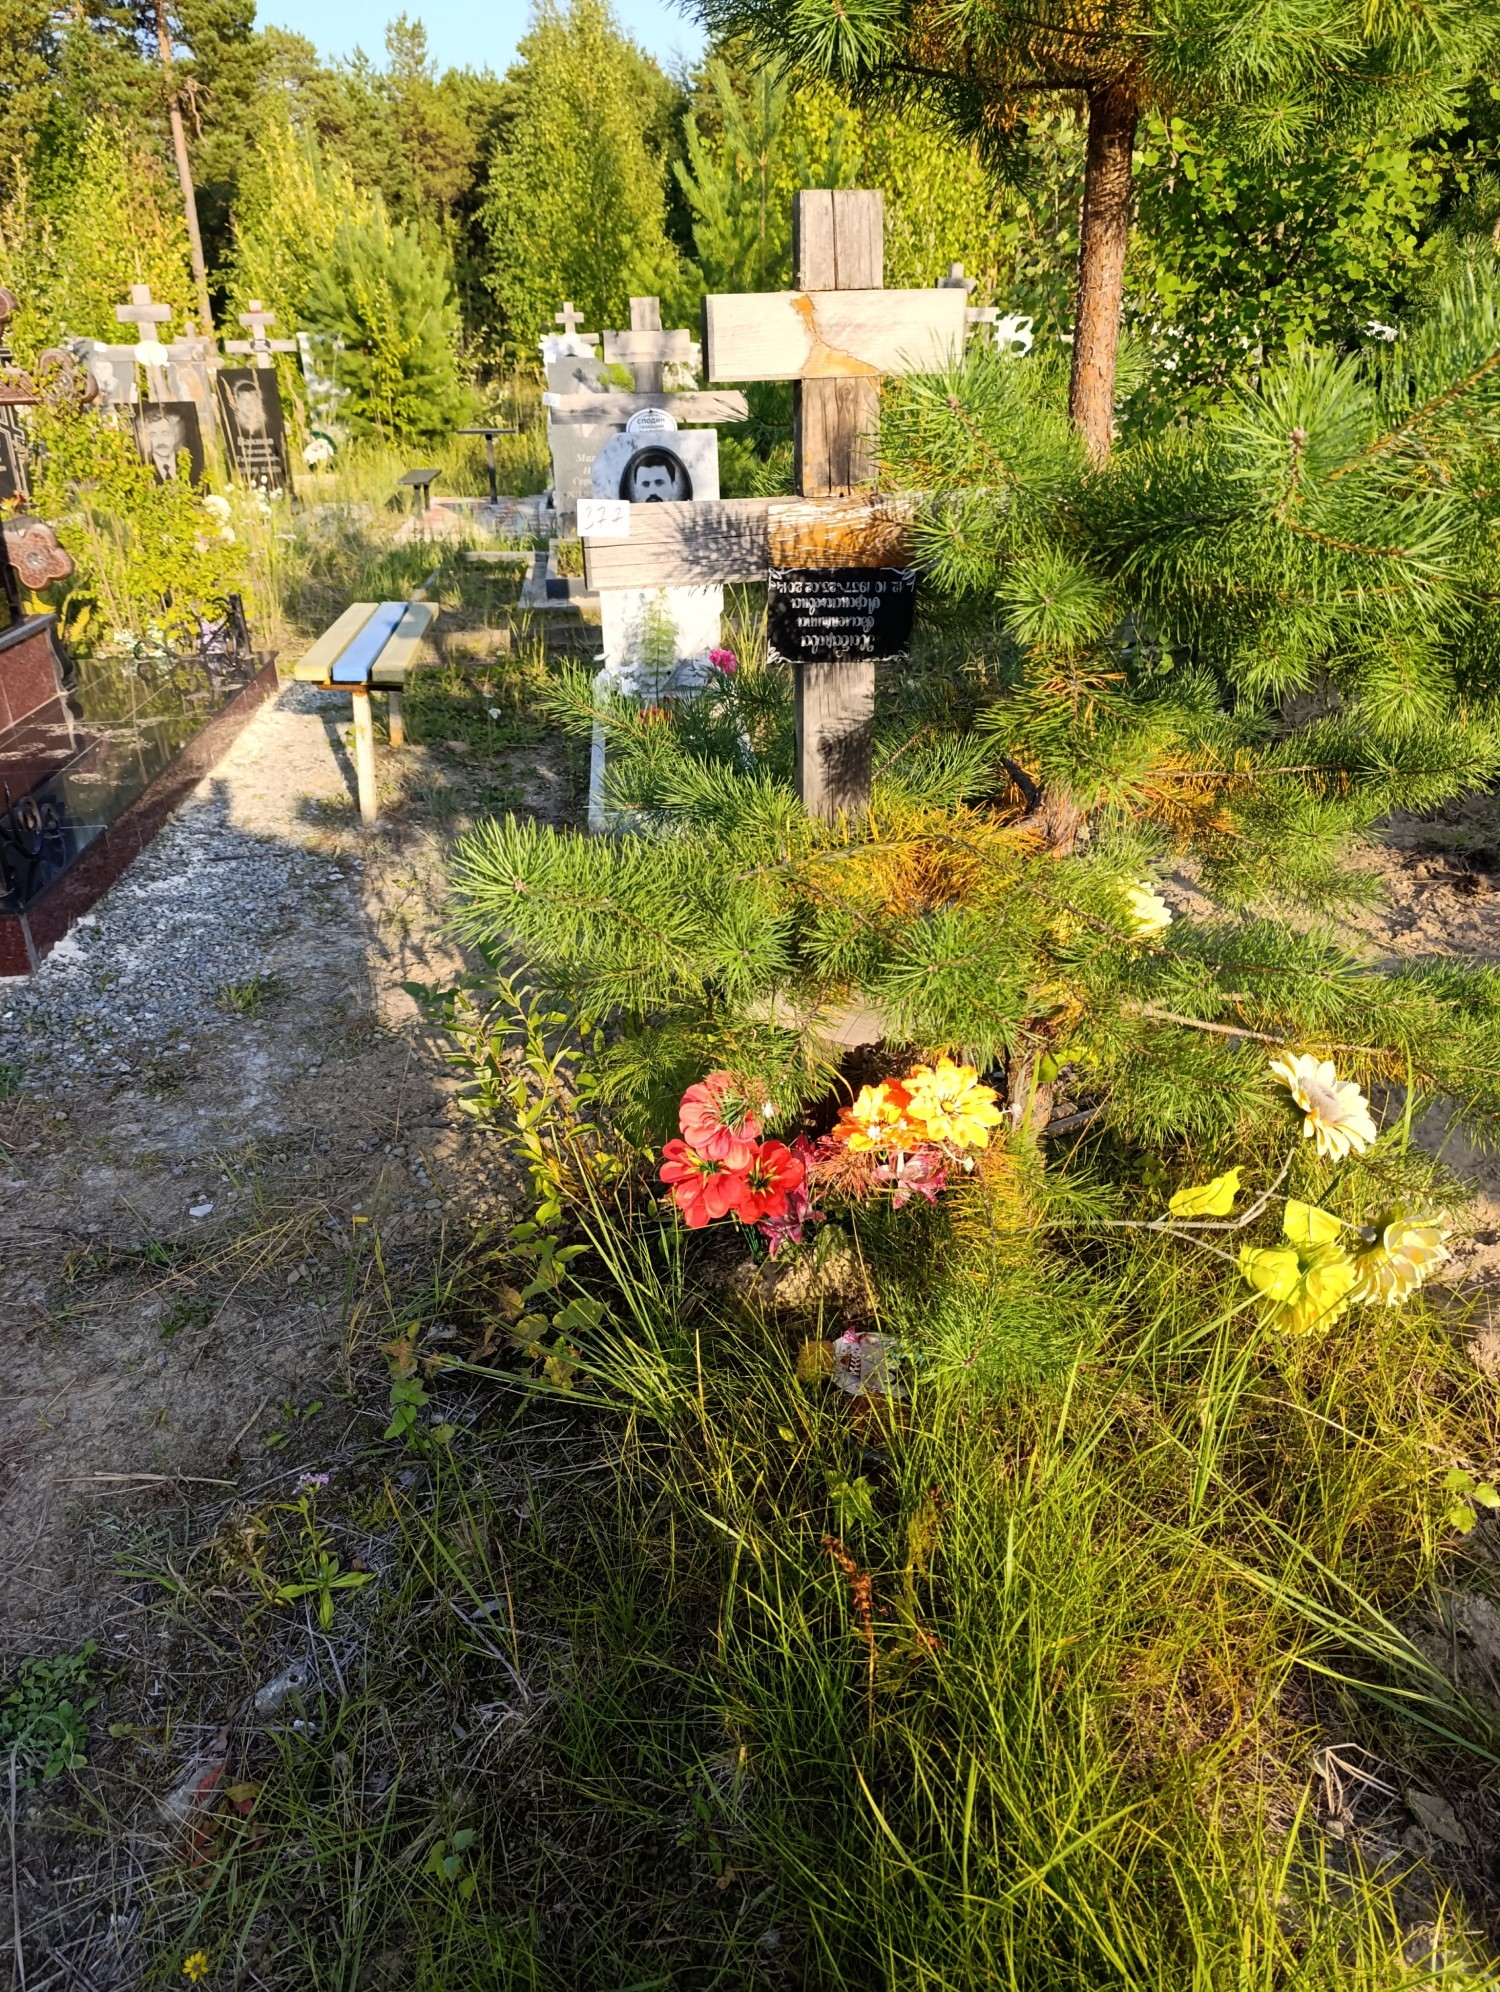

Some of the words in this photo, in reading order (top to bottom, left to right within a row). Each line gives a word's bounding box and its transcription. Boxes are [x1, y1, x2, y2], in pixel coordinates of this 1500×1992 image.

[790, 594, 881, 615] Афанасьевна
[796, 615, 875, 633] Валентина
[800, 632, 875, 654] Хабарова
